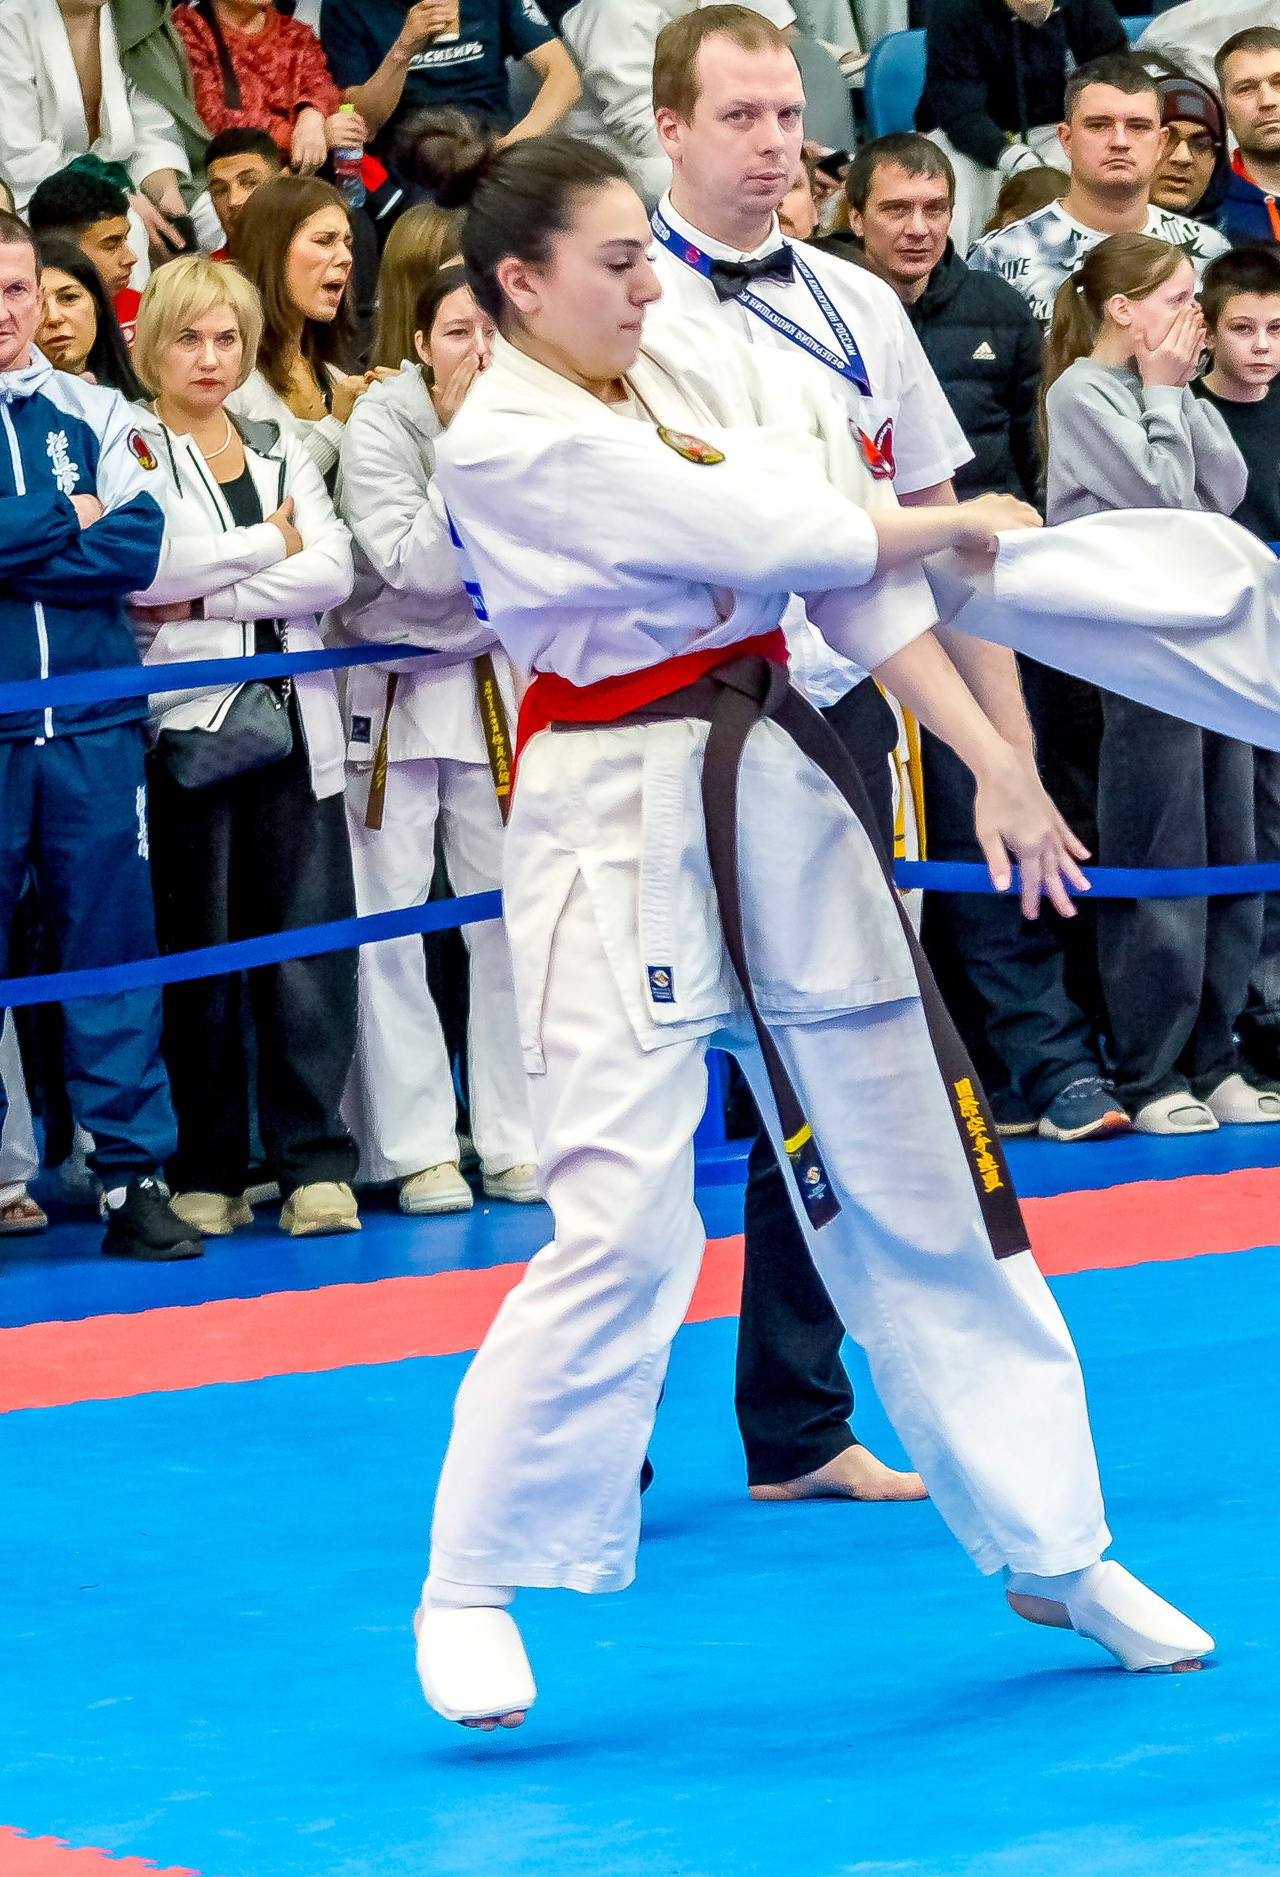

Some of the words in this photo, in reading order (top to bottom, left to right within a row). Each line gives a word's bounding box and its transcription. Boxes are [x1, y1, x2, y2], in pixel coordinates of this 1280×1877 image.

[748, 298, 798, 336] КИОКУШИН
[795, 328, 846, 370] ФЕДЕРАЦИЯ
[833, 320, 858, 357] РОССИИ
